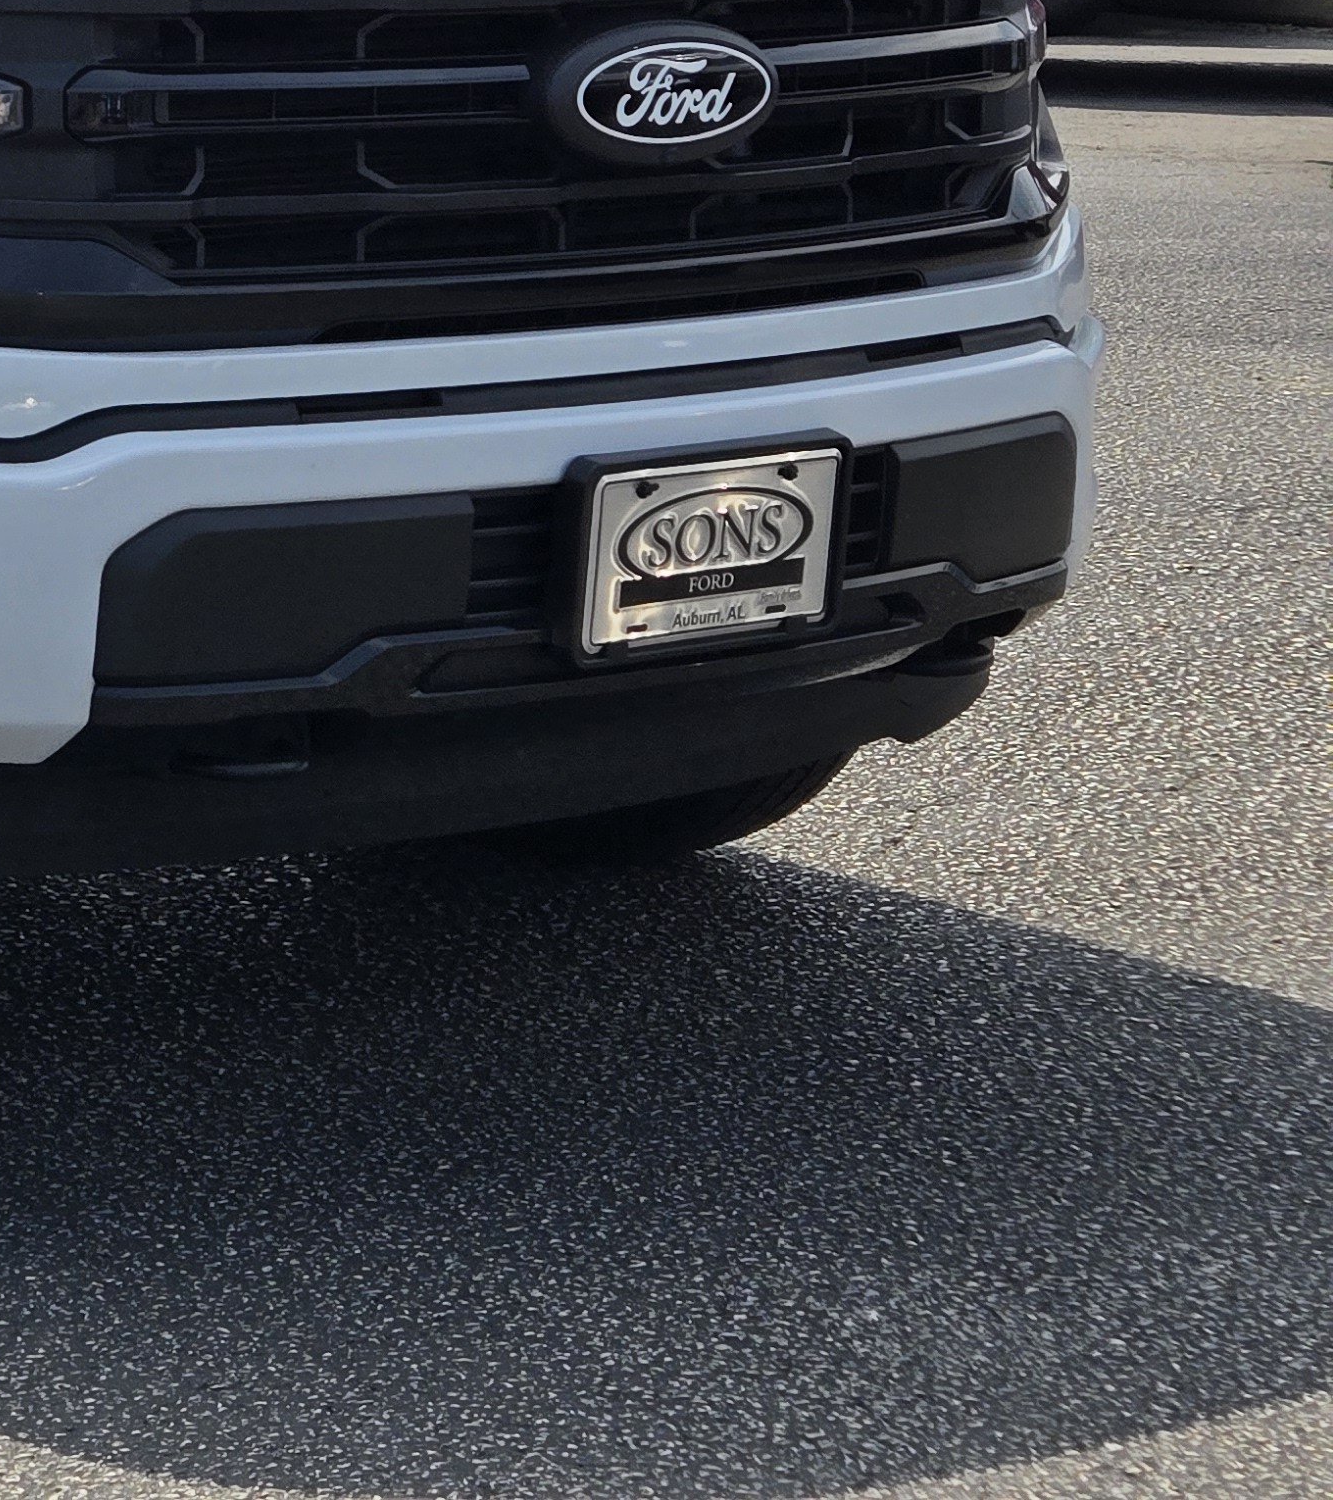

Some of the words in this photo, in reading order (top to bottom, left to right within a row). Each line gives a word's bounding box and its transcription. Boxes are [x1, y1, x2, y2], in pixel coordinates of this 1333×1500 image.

[615, 57, 737, 128] Ford
[645, 500, 784, 568] SONS
[688, 573, 735, 593] FORD
[671, 607, 724, 629] Auburn,
[727, 605, 746, 621] AL
